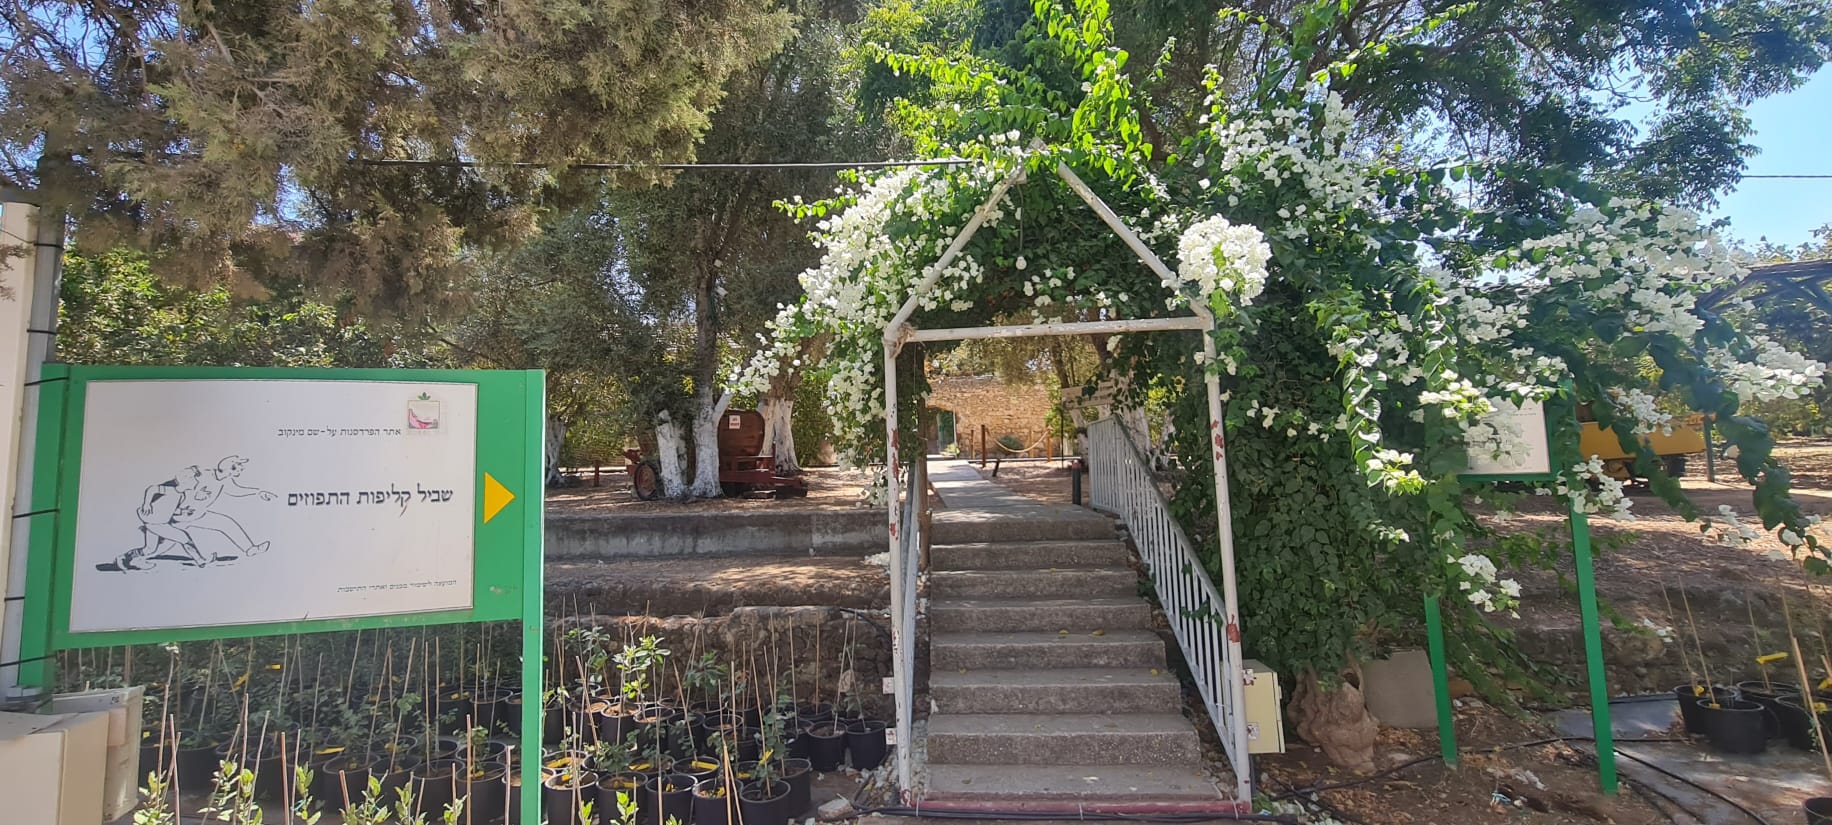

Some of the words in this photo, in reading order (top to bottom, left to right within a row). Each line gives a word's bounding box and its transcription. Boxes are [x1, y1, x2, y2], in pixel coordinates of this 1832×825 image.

[277, 428, 305, 438] מינקוב
[339, 428, 380, 437] הפרדסנות
[383, 428, 401, 436] אתר
[287, 491, 350, 506] התפוזים
[356, 483, 411, 507] קליפות
[417, 482, 453, 503] שביל
